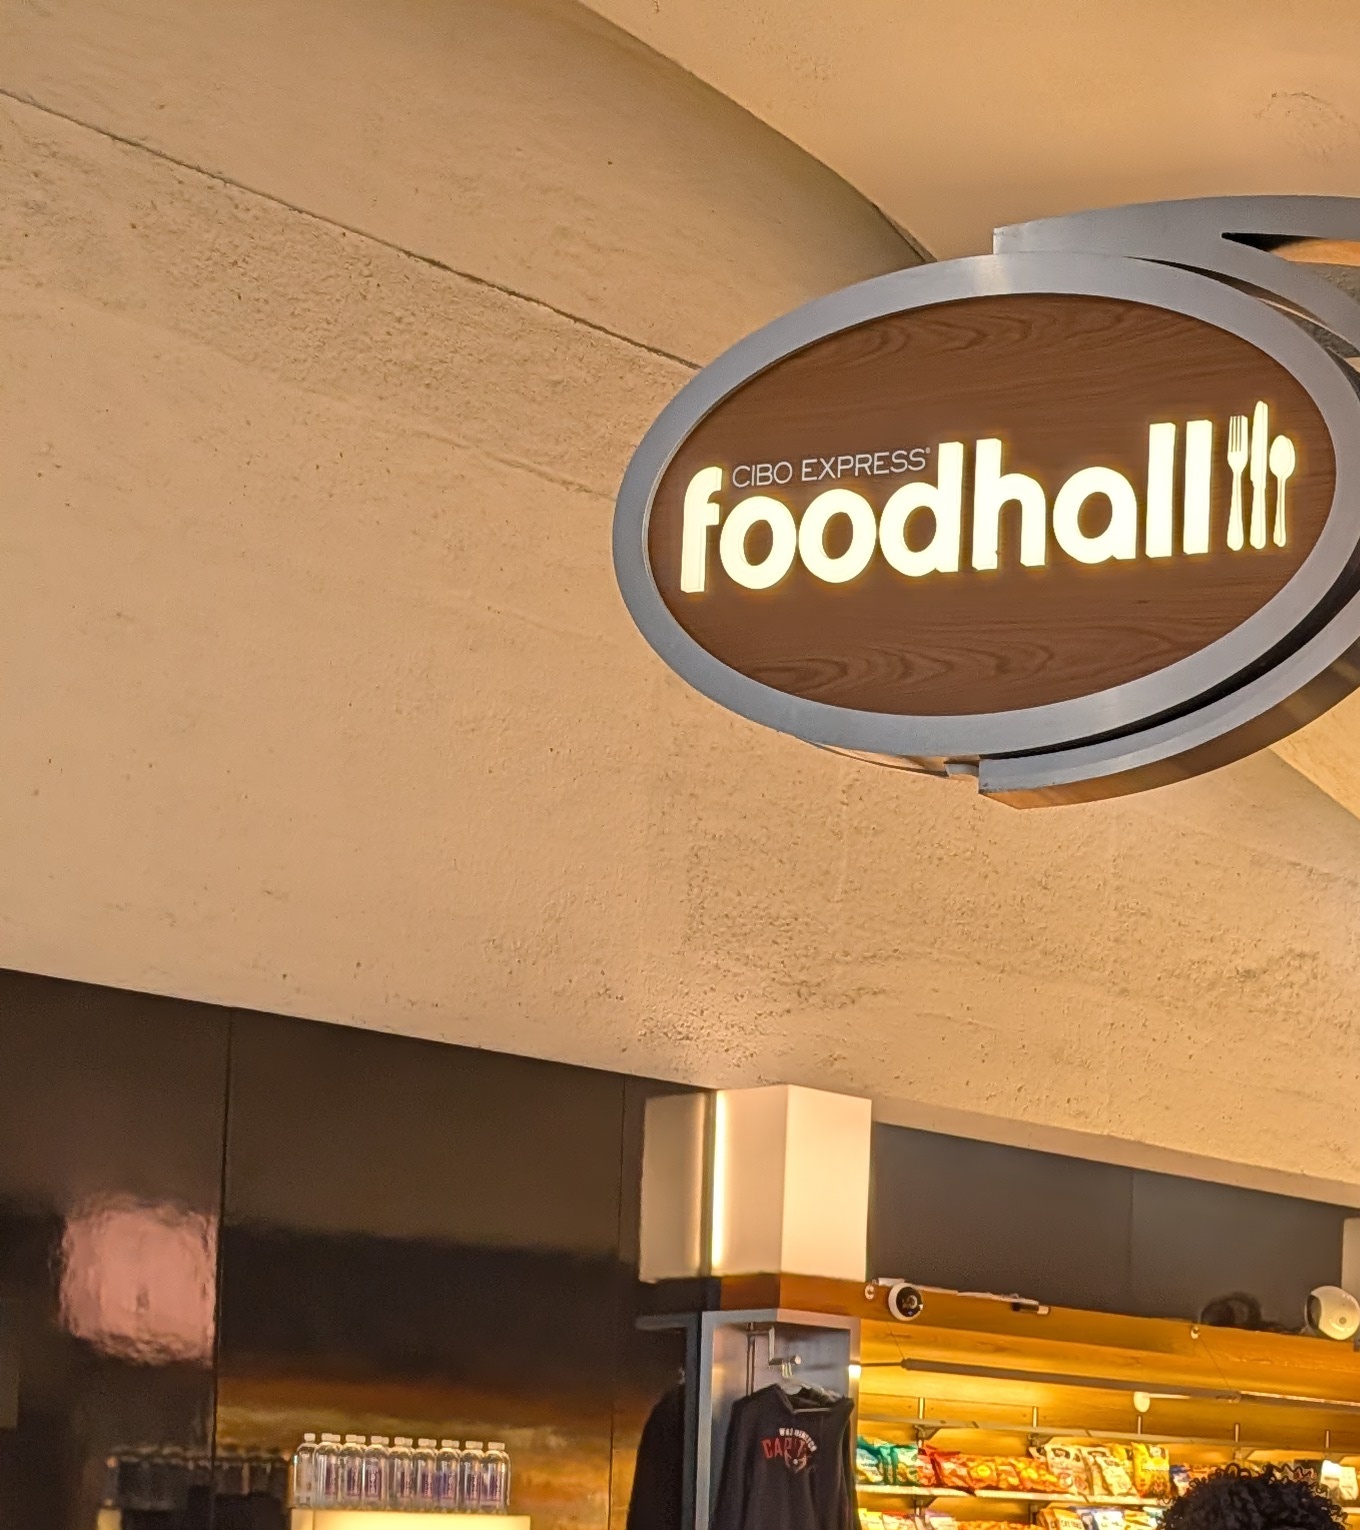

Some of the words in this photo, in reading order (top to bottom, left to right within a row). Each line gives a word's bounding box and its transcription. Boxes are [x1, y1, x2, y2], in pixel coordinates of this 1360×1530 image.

[680, 419, 1213, 593] foodhall
[732, 460, 793, 488] CIBO
[801, 449, 927, 480] EXPRESS
